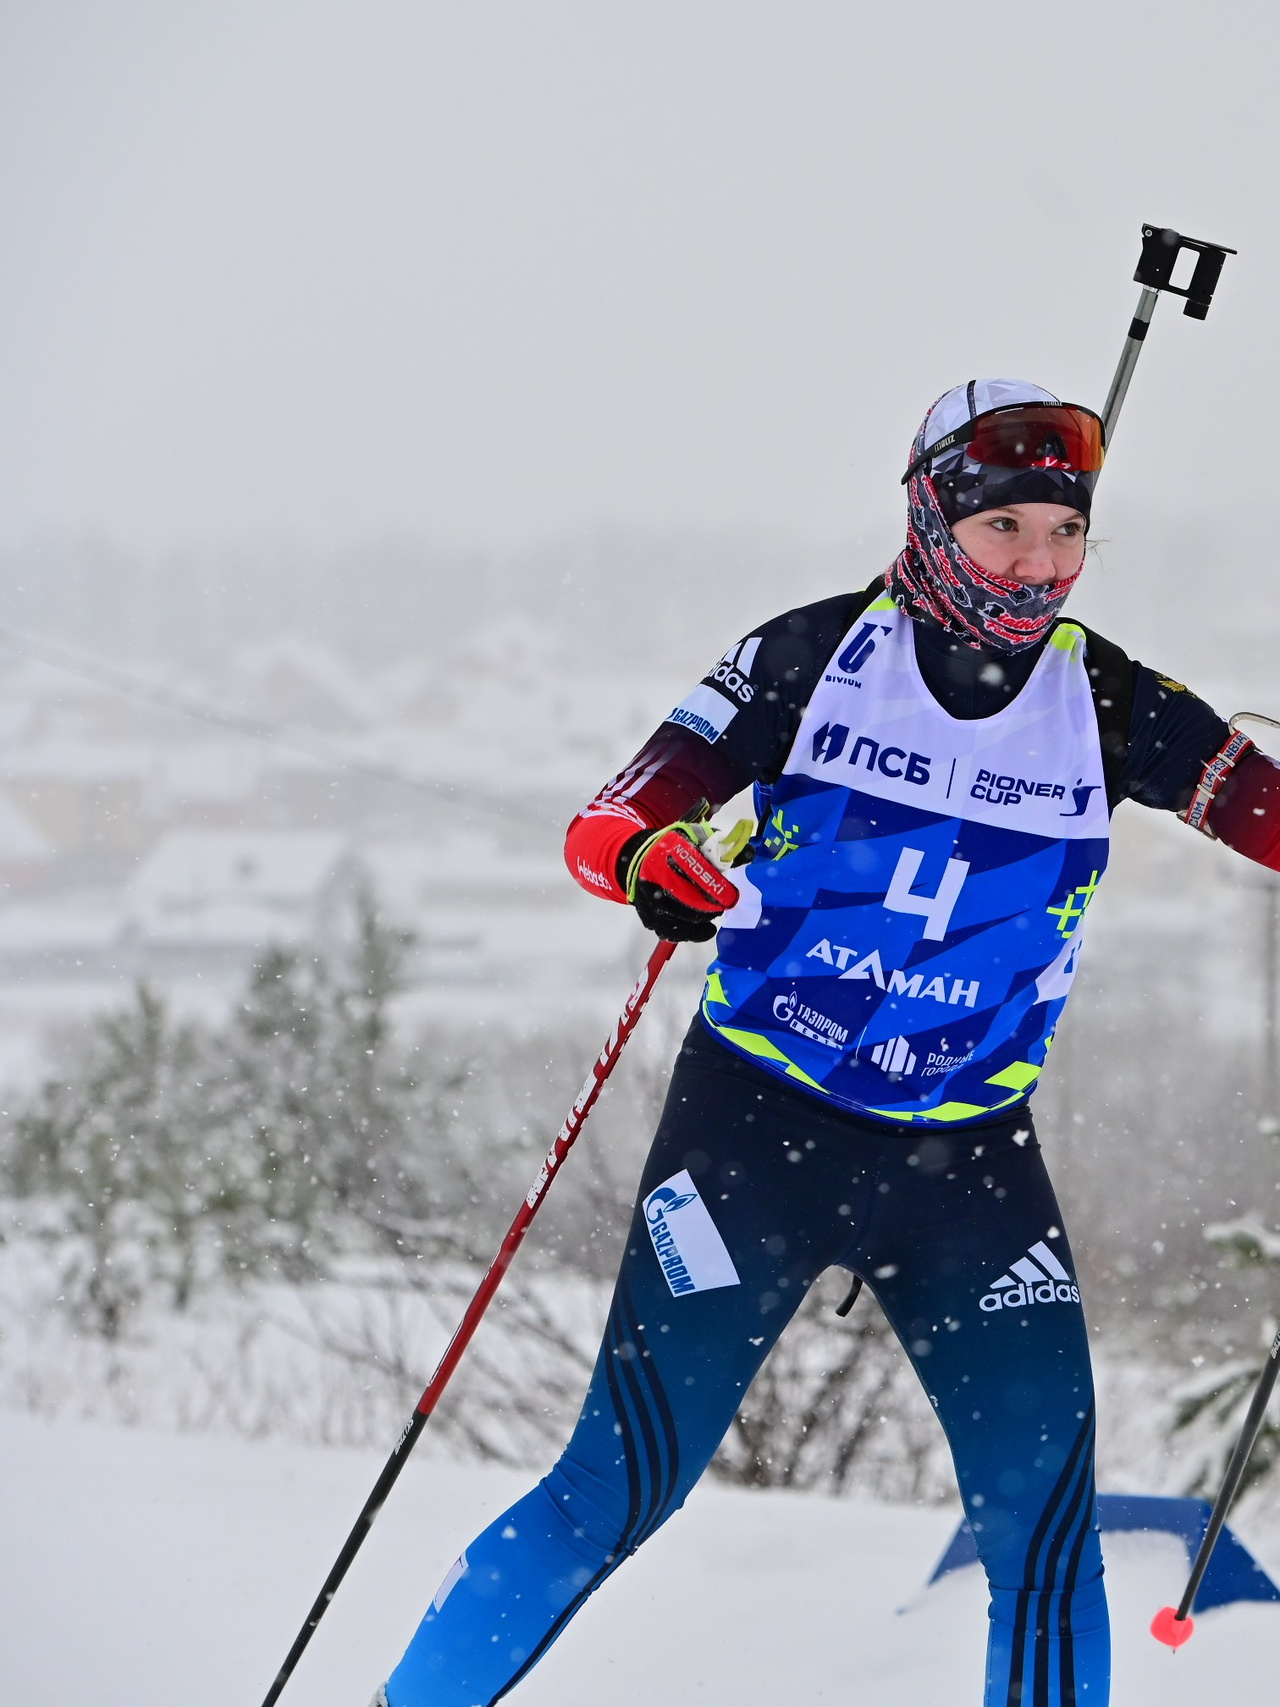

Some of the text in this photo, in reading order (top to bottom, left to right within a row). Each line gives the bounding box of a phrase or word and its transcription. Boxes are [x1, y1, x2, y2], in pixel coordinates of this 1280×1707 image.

[708, 661, 755, 703] idas
[825, 674, 862, 689] BIVIUM
[673, 709, 720, 743] GAZPROM
[848, 736, 932, 786] ПСБ
[970, 786, 1022, 806] CUP
[976, 768, 1067, 800] PIONER
[673, 844, 725, 895] NORDSKI
[883, 846, 971, 942] 4
[805, 938, 980, 1009] АТАМАН
[797, 1003, 849, 1044] ГАЗПРОМ
[650, 1221, 696, 1295] GAZPROM
[979, 1279, 1080, 1312] adidas
